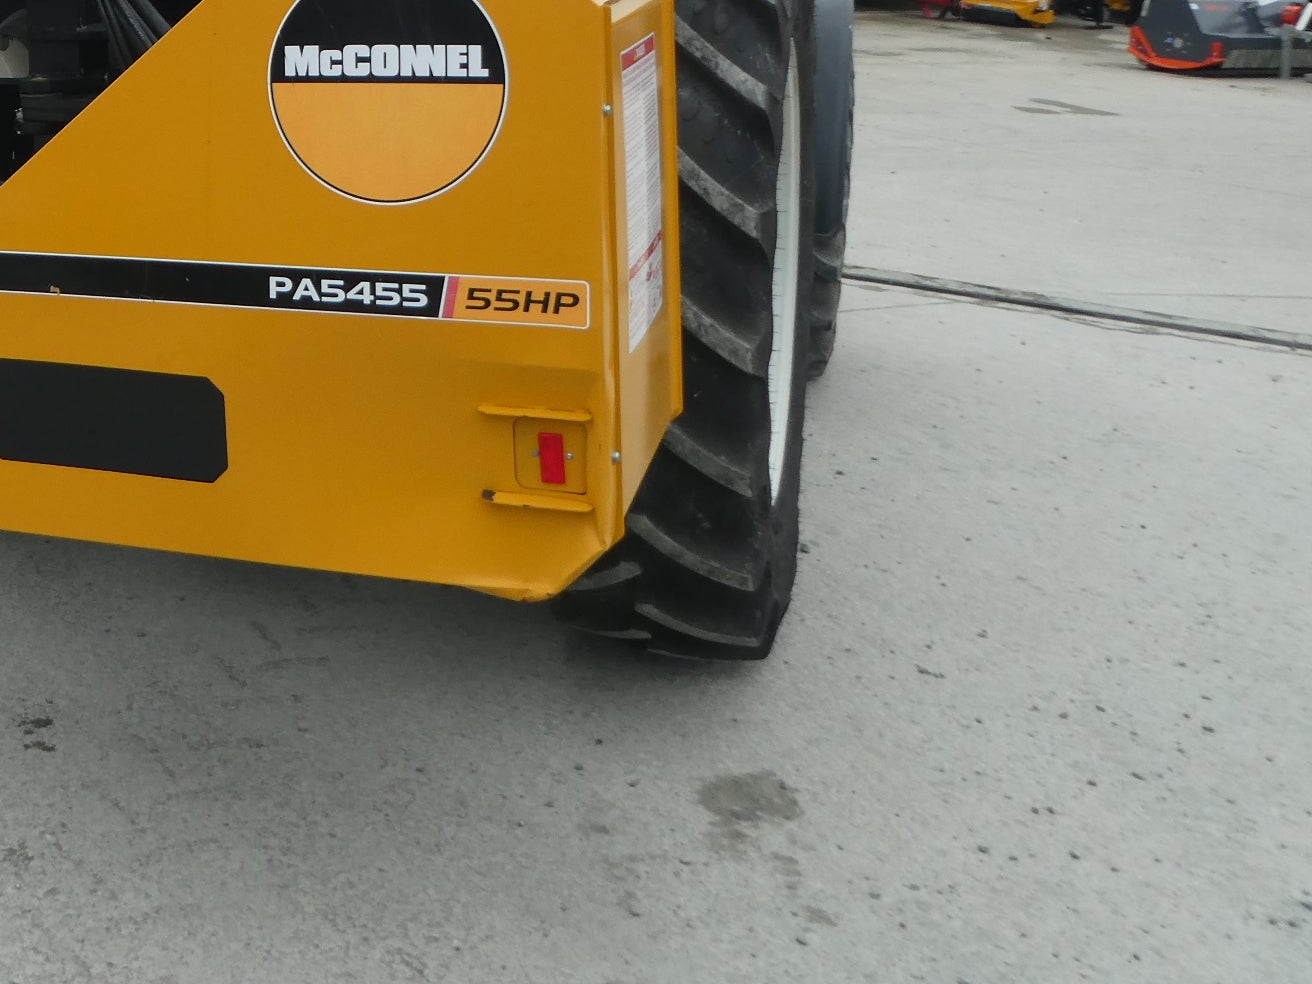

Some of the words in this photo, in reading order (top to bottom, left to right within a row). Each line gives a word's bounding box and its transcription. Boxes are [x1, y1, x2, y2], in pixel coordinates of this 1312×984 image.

[285, 44, 489, 77] McCONNEL
[269, 276, 428, 308] PA5455
[465, 287, 581, 315] 55HP
